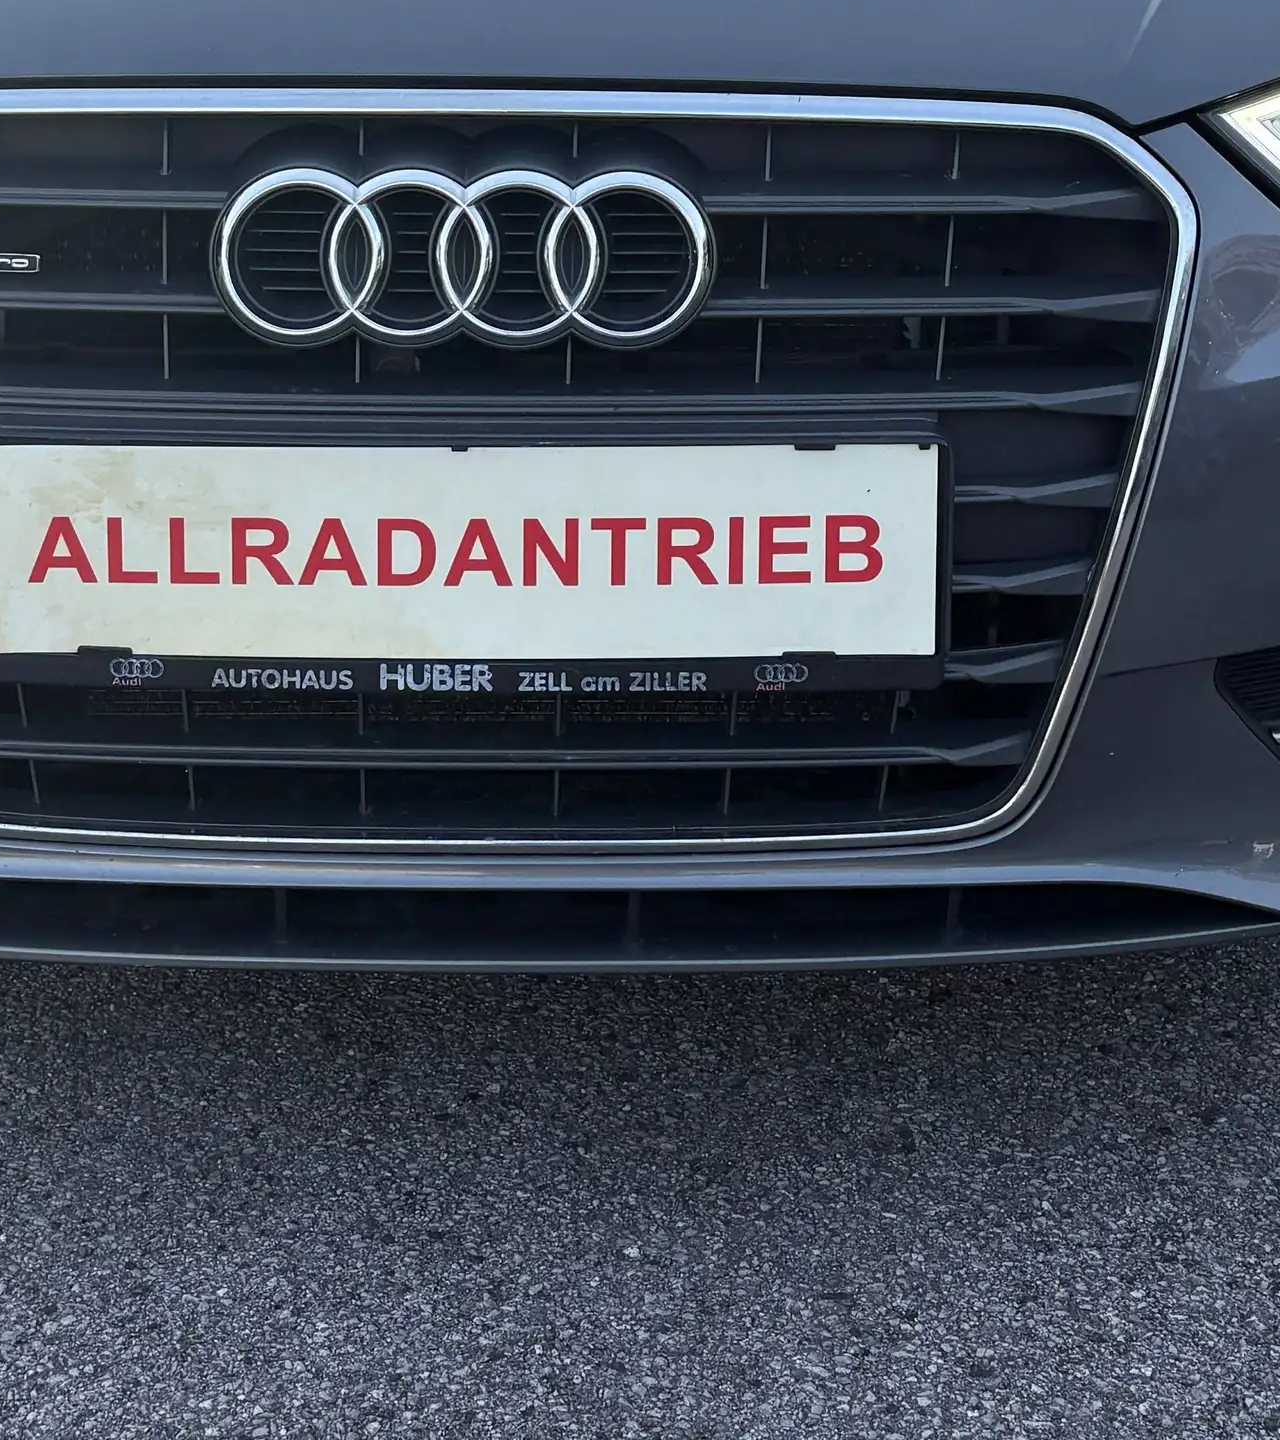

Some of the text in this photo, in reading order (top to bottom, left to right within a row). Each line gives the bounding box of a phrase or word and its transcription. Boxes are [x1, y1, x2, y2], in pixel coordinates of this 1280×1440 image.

[28, 515, 885, 587] ALLRADANTRIEB
[112, 677, 142, 687] Audi
[211, 663, 708, 693] AUTOHAUS HUBER ZELL am ZILLER
[756, 681, 786, 692] Audi
